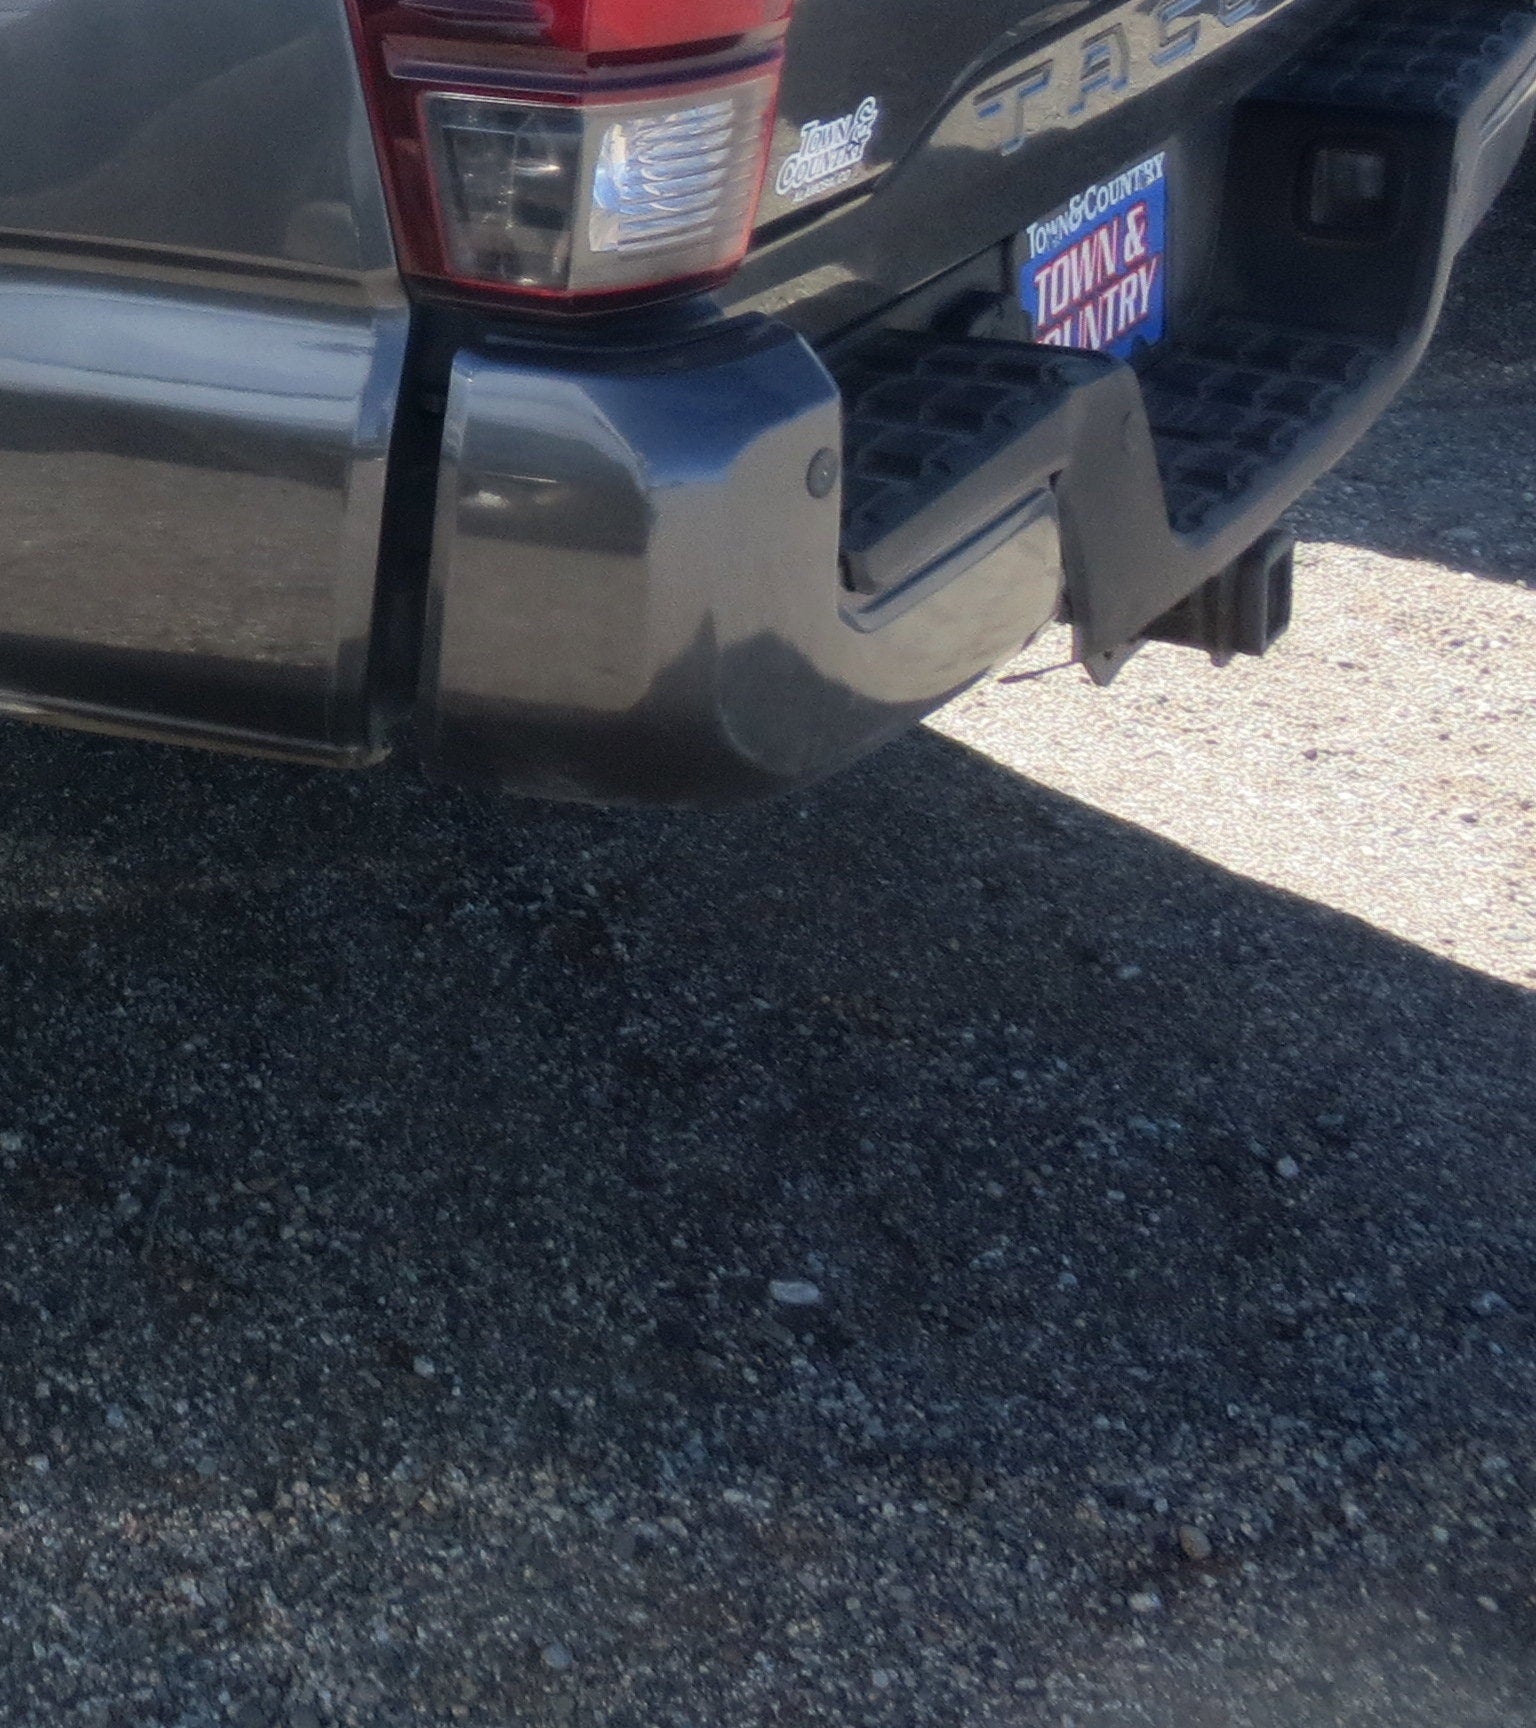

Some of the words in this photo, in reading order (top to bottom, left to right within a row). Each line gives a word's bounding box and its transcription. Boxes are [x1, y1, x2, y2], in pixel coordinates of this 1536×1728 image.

[775, 139, 867, 195] COUNTRY
[800, 115, 853, 157] TOWN
[1033, 216, 1120, 331] TOWN
[1123, 201, 1148, 265] &
[1035, 254, 1160, 351] UNTRY
